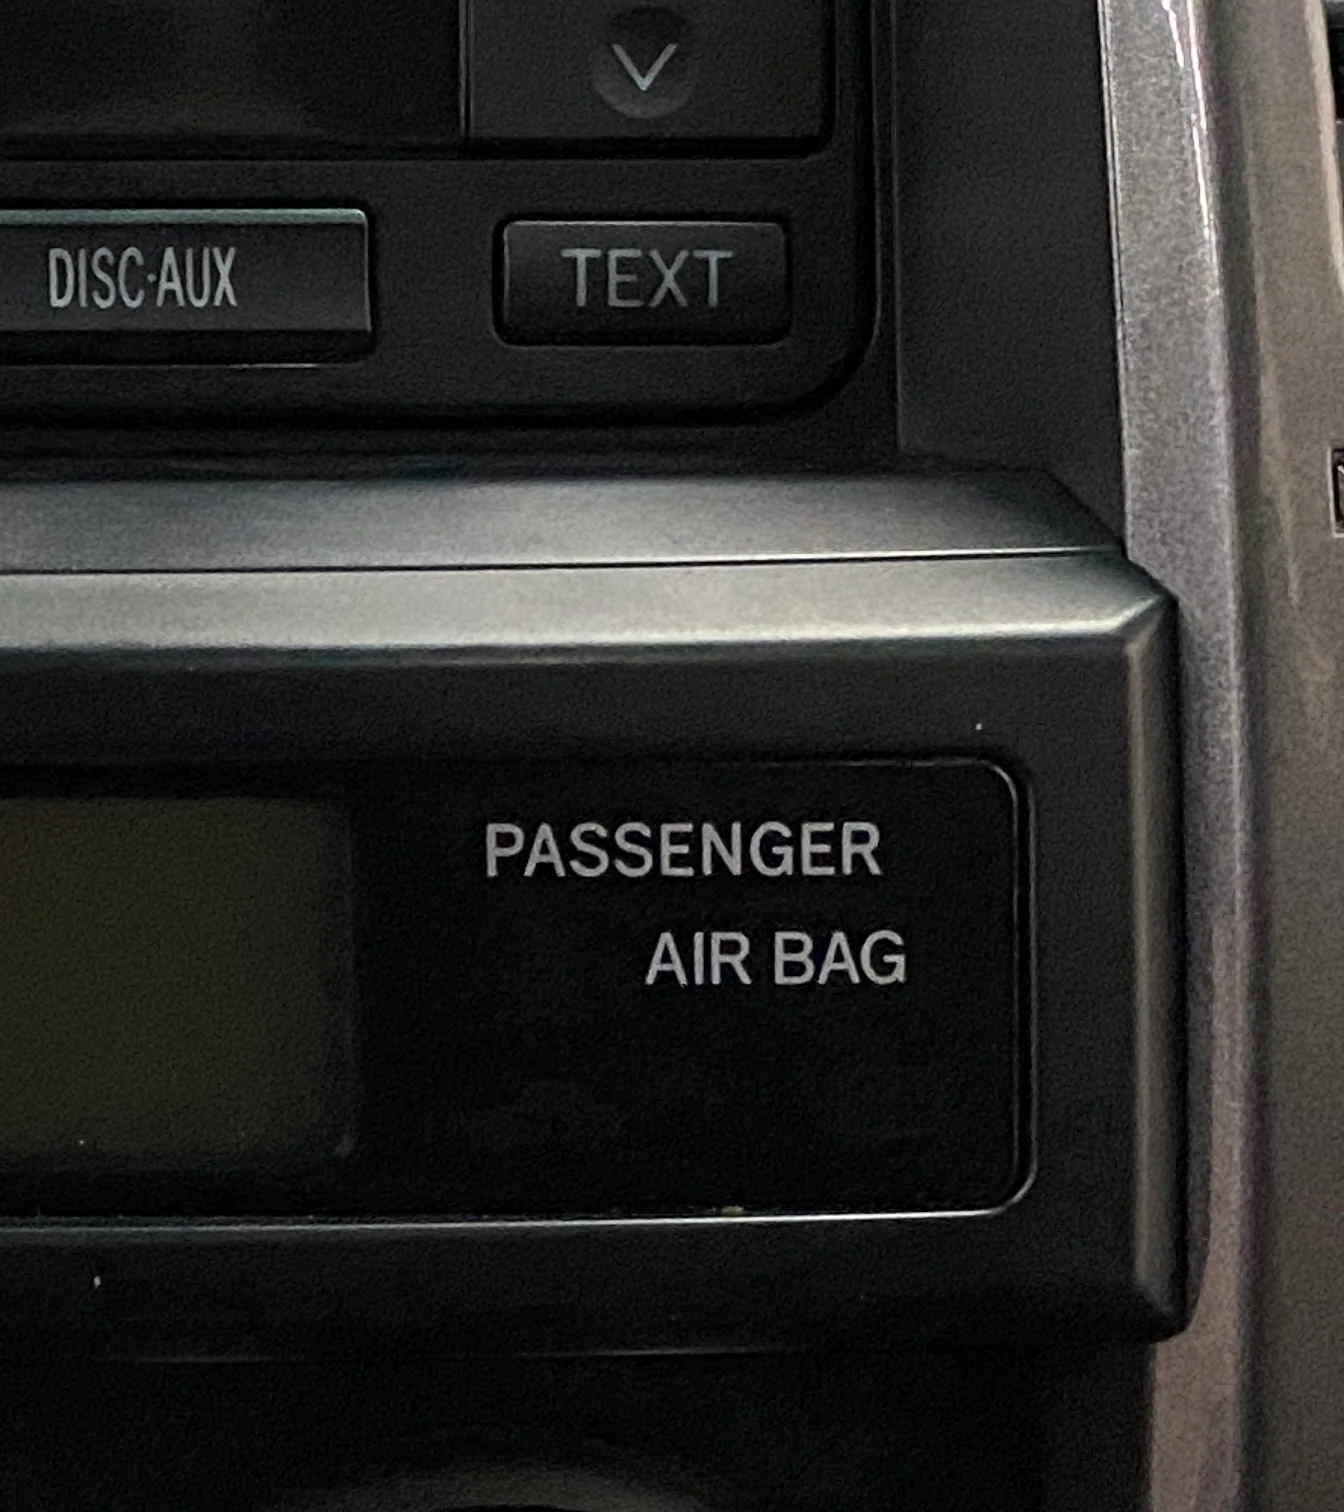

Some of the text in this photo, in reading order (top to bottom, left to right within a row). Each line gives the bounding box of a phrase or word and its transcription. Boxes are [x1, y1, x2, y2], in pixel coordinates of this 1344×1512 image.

[561, 248, 735, 309] TEXT
[485, 821, 882, 878] PASSENGER
[644, 929, 907, 986] AIR BAG
